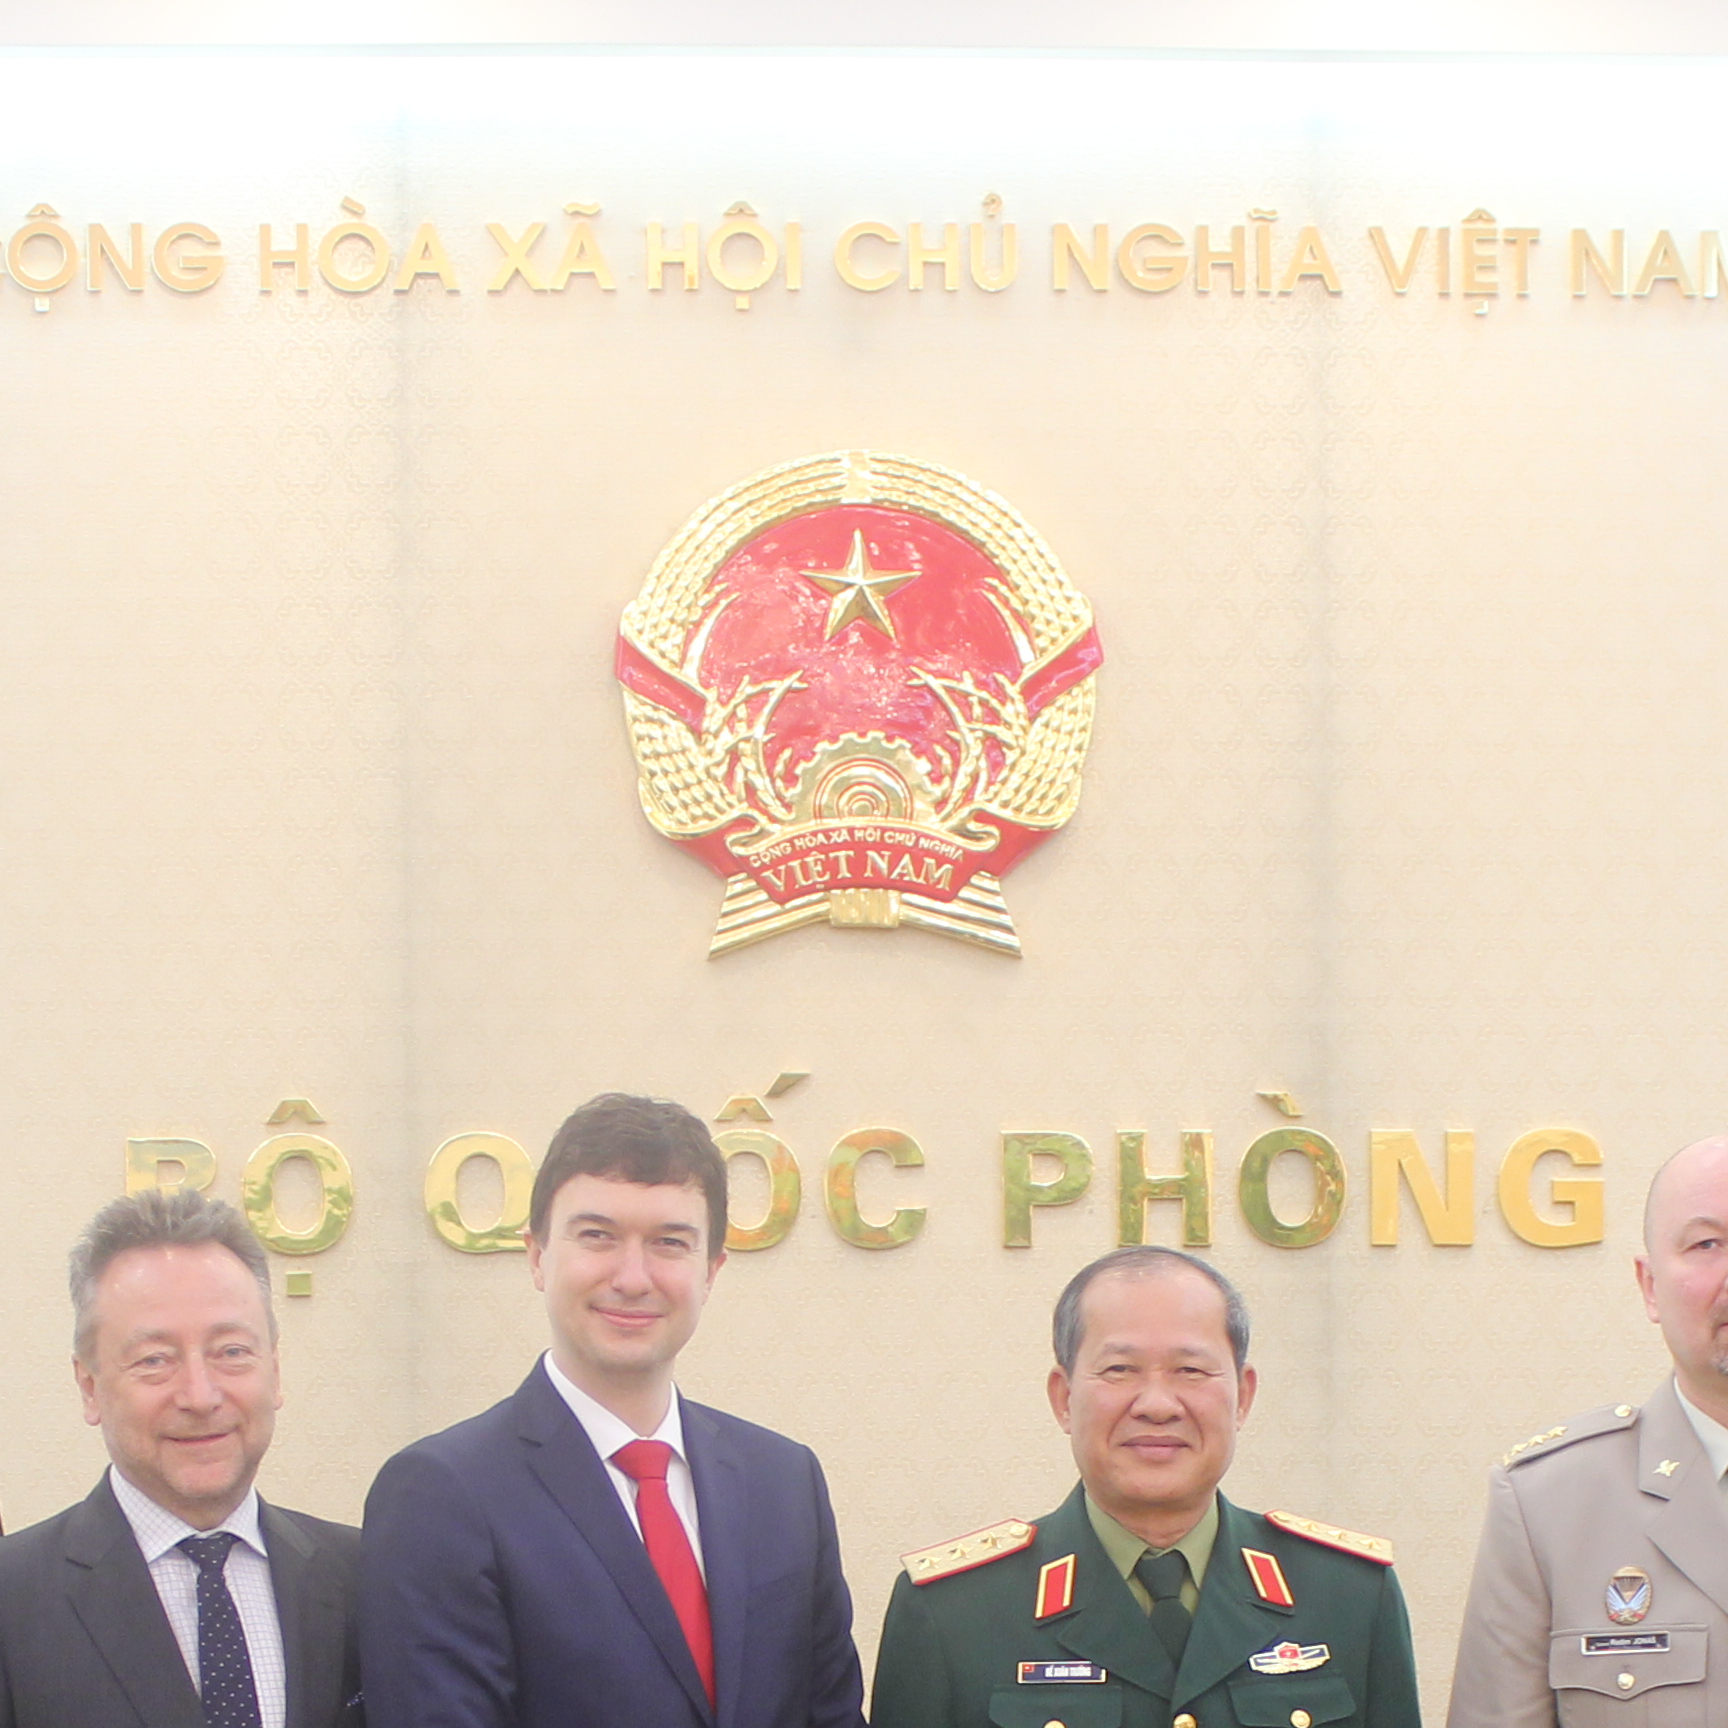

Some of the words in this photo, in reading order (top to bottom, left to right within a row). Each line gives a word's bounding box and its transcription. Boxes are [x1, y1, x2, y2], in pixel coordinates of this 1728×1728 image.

[259, 196, 461, 295] HÒA
[486, 202, 617, 294] XÃ
[646, 200, 803, 311] HỘI
[833, 192, 1019, 293] CHỦ
[1052, 208, 1343, 295] NGHĨA
[1368, 208, 1542, 316] VIỆT
[760, 850, 856, 892] VIỆT
[863, 850, 954, 891] NAM
[424, 1071, 928, 1253] QỐC
[1000, 1090, 1605, 1248] PHÒNG
